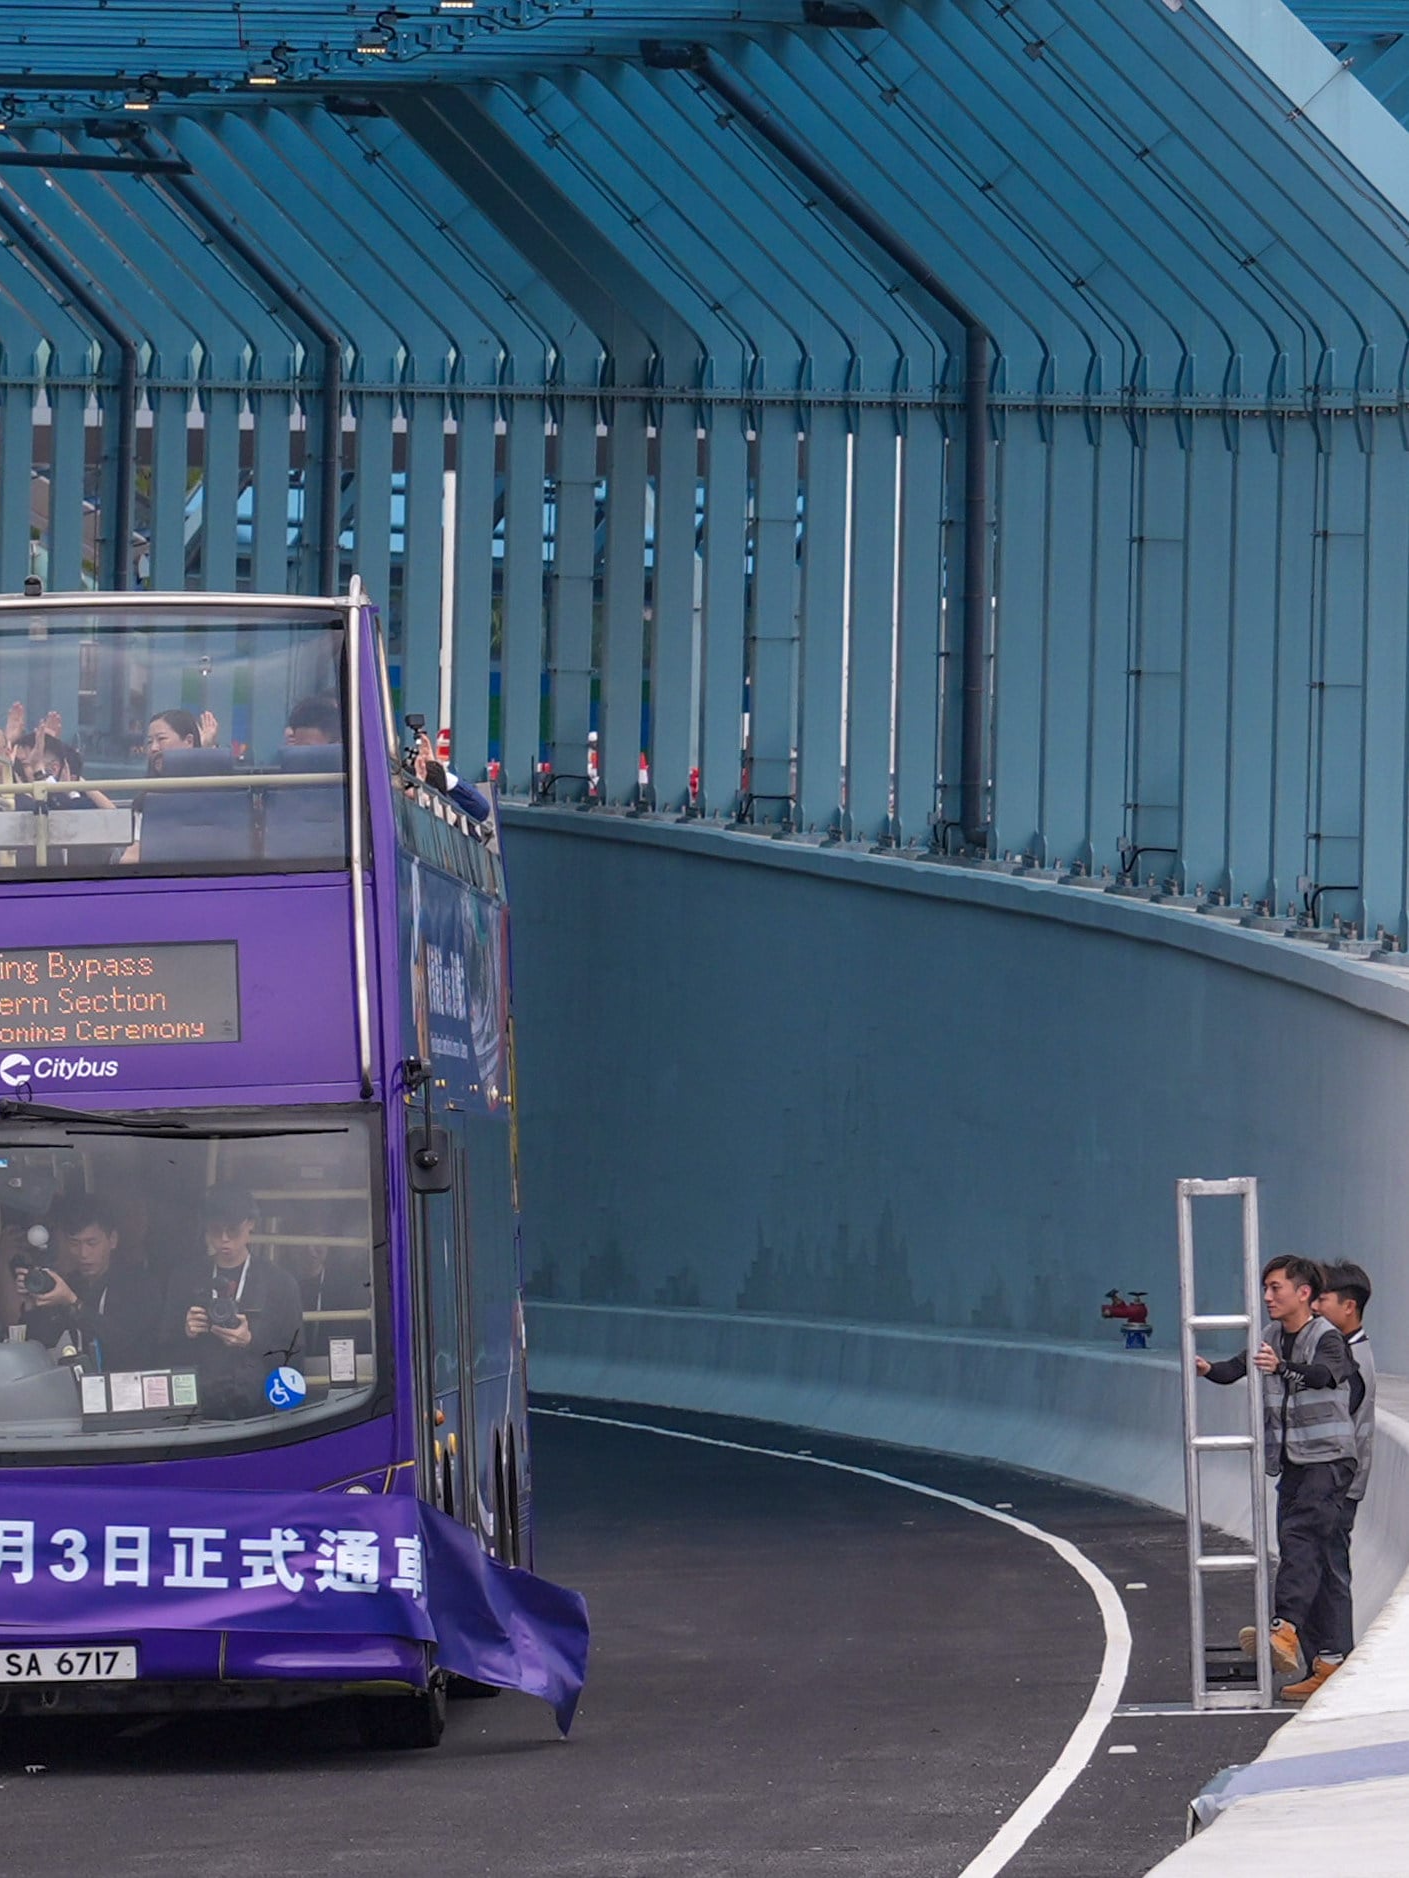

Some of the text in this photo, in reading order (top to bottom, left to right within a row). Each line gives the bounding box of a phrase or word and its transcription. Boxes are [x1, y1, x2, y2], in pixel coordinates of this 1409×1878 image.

[47, 951, 155, 984] Bypass
[58, 986, 167, 1015] Section
[75, 1020, 205, 1042] Ceremony
[33, 1056, 118, 1081] Citybus
[290, 1374, 297, 1385] 1
[6, 1651, 119, 1676] SA 6717
